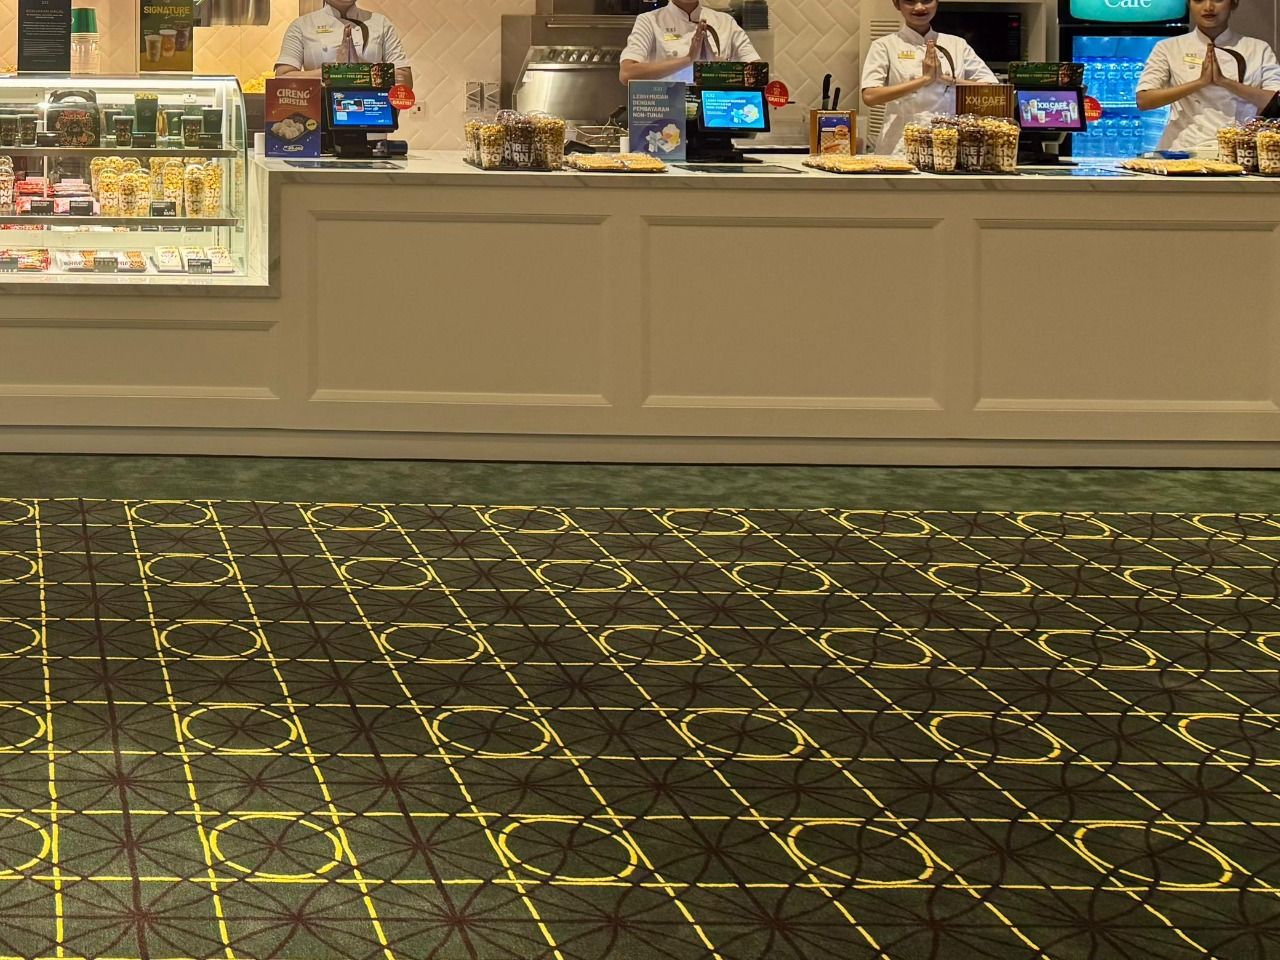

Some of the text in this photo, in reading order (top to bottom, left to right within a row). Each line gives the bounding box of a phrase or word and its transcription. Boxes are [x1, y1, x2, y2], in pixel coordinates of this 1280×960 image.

[143, 6, 190, 14] SIGNATURE
[277, 88, 311, 99] CIRENG
[279, 97, 308, 106] KRISTAL
[965, 96, 980, 105] XXI
